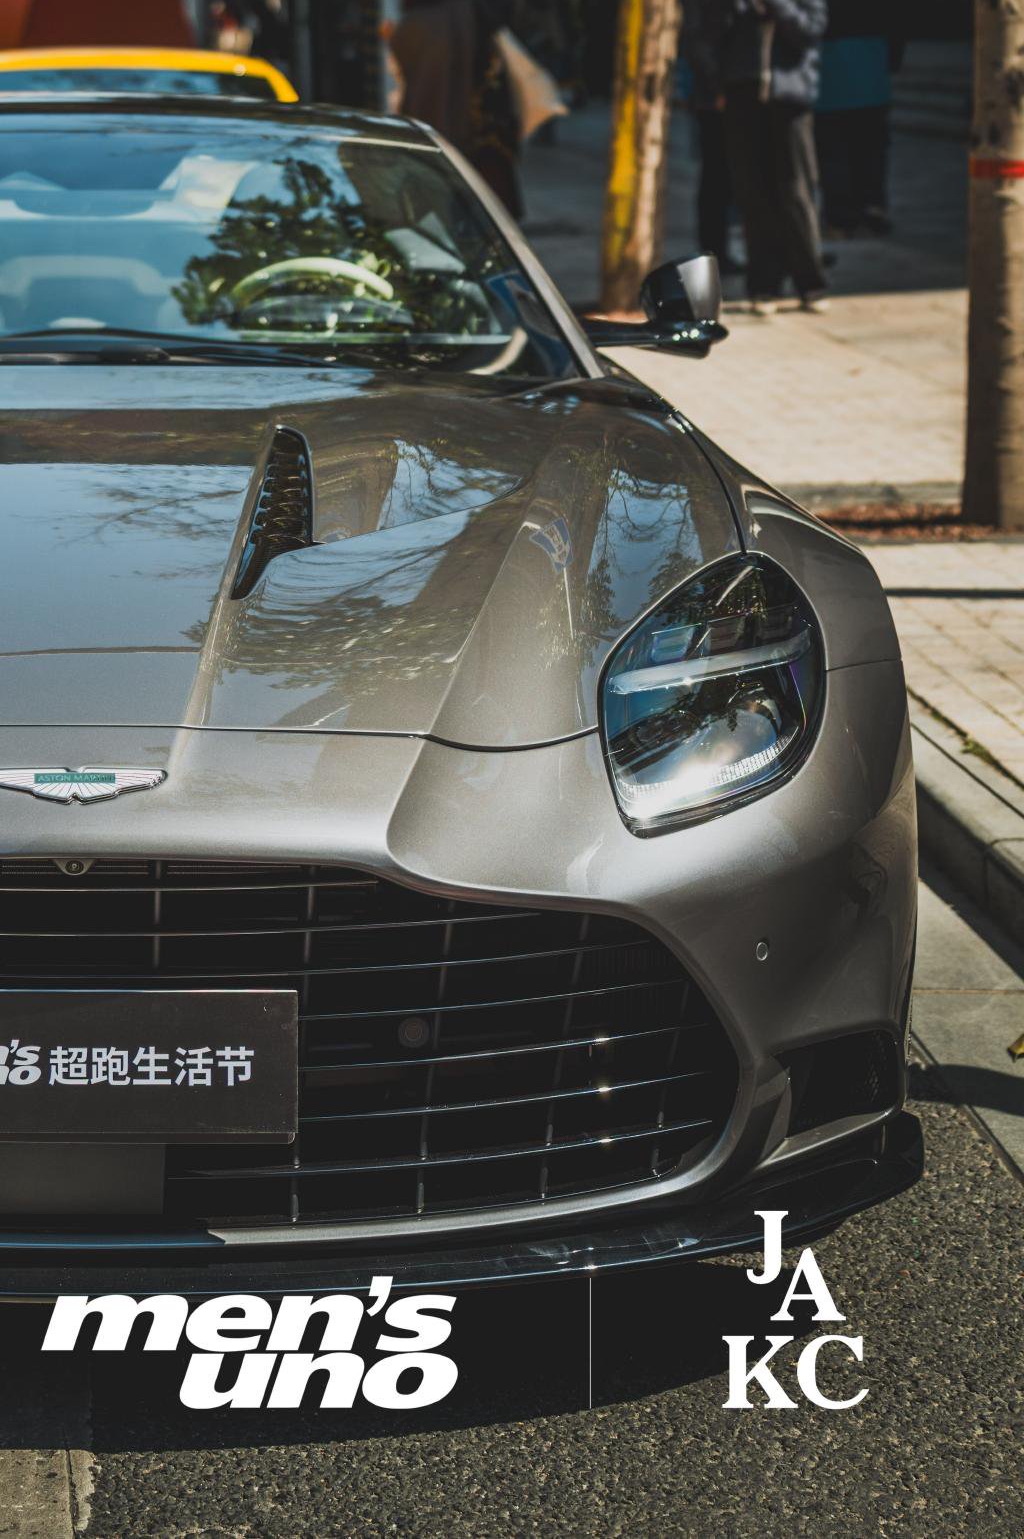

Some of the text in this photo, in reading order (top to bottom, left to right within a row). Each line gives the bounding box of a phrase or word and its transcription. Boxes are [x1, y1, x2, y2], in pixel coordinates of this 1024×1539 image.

[38, 773, 71, 782] ASTON
[48, 1045, 255, 1086] 超跑生活节
